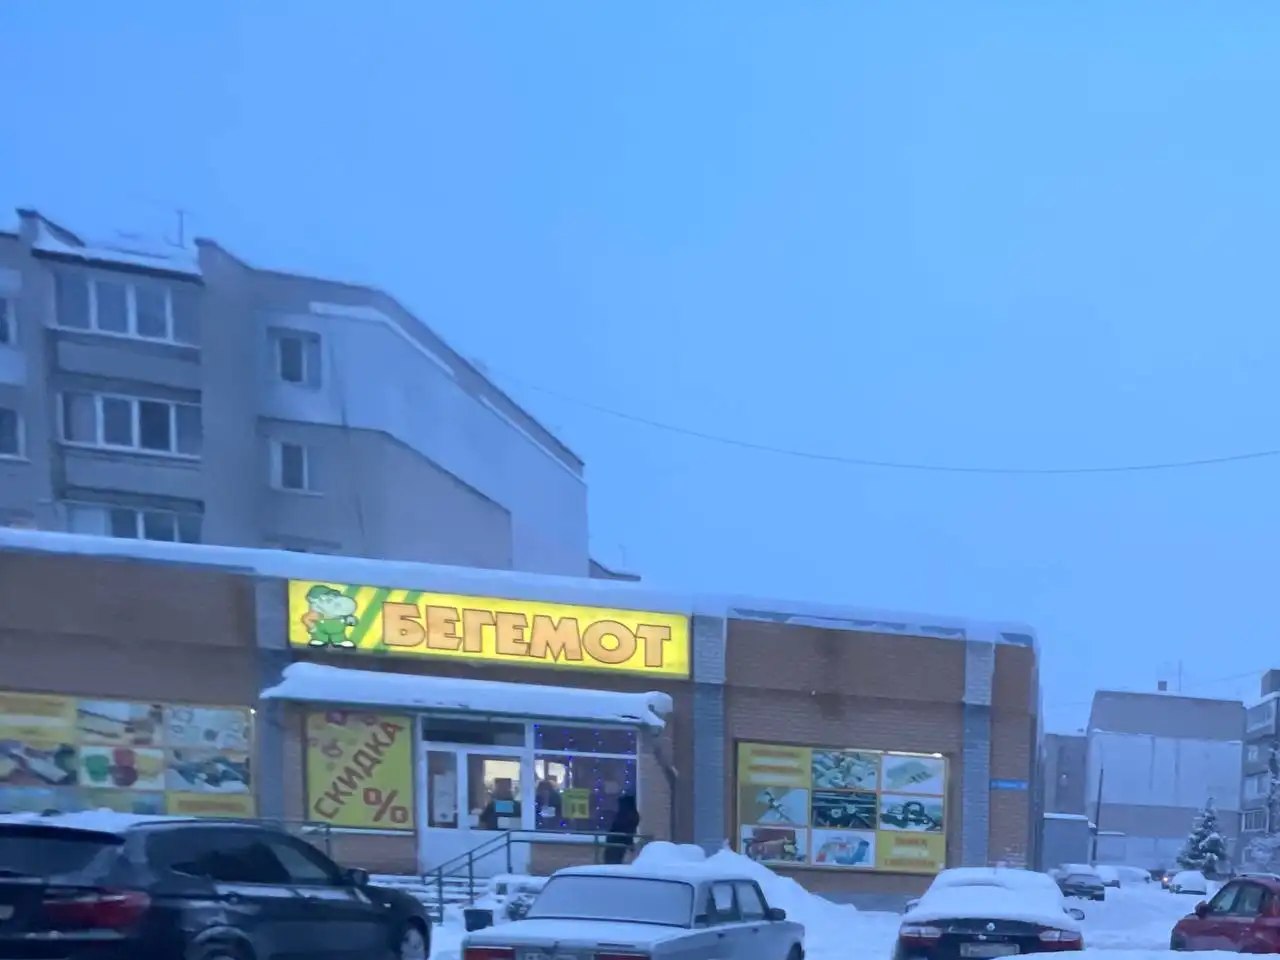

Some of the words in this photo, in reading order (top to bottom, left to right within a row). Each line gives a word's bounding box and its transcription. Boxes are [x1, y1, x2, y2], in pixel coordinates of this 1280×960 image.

[382, 602, 672, 668] БЕГЕМОТ
[313, 722, 405, 819] СКИДКА
[362, 787, 409, 823] %
